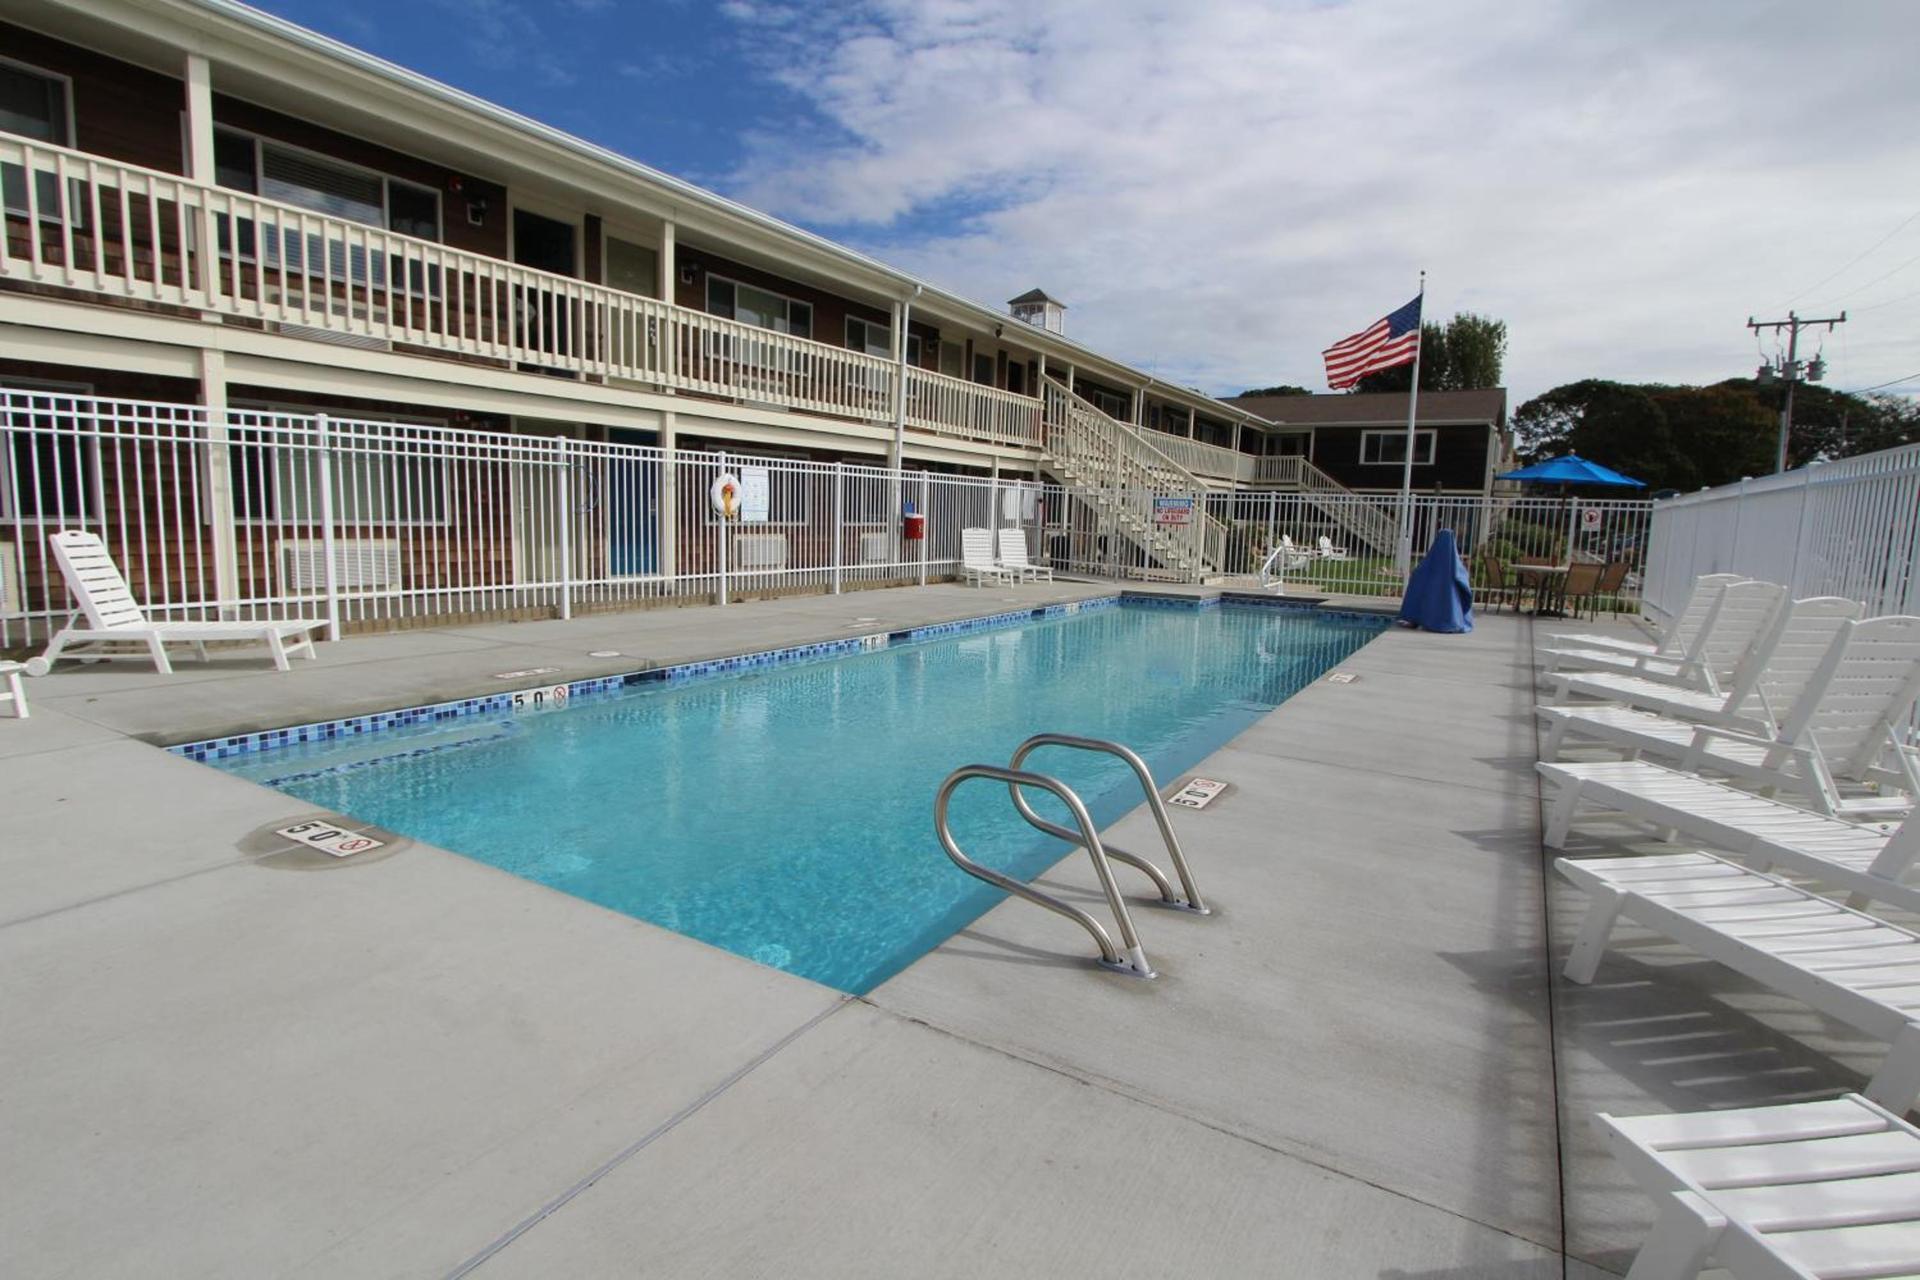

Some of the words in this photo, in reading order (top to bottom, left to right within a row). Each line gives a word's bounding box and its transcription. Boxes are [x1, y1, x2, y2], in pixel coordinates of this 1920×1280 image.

[515, 694, 524, 706] 5
[1185, 790, 1209, 798] 0
[287, 823, 320, 833] 5
[308, 830, 341, 841] 0
